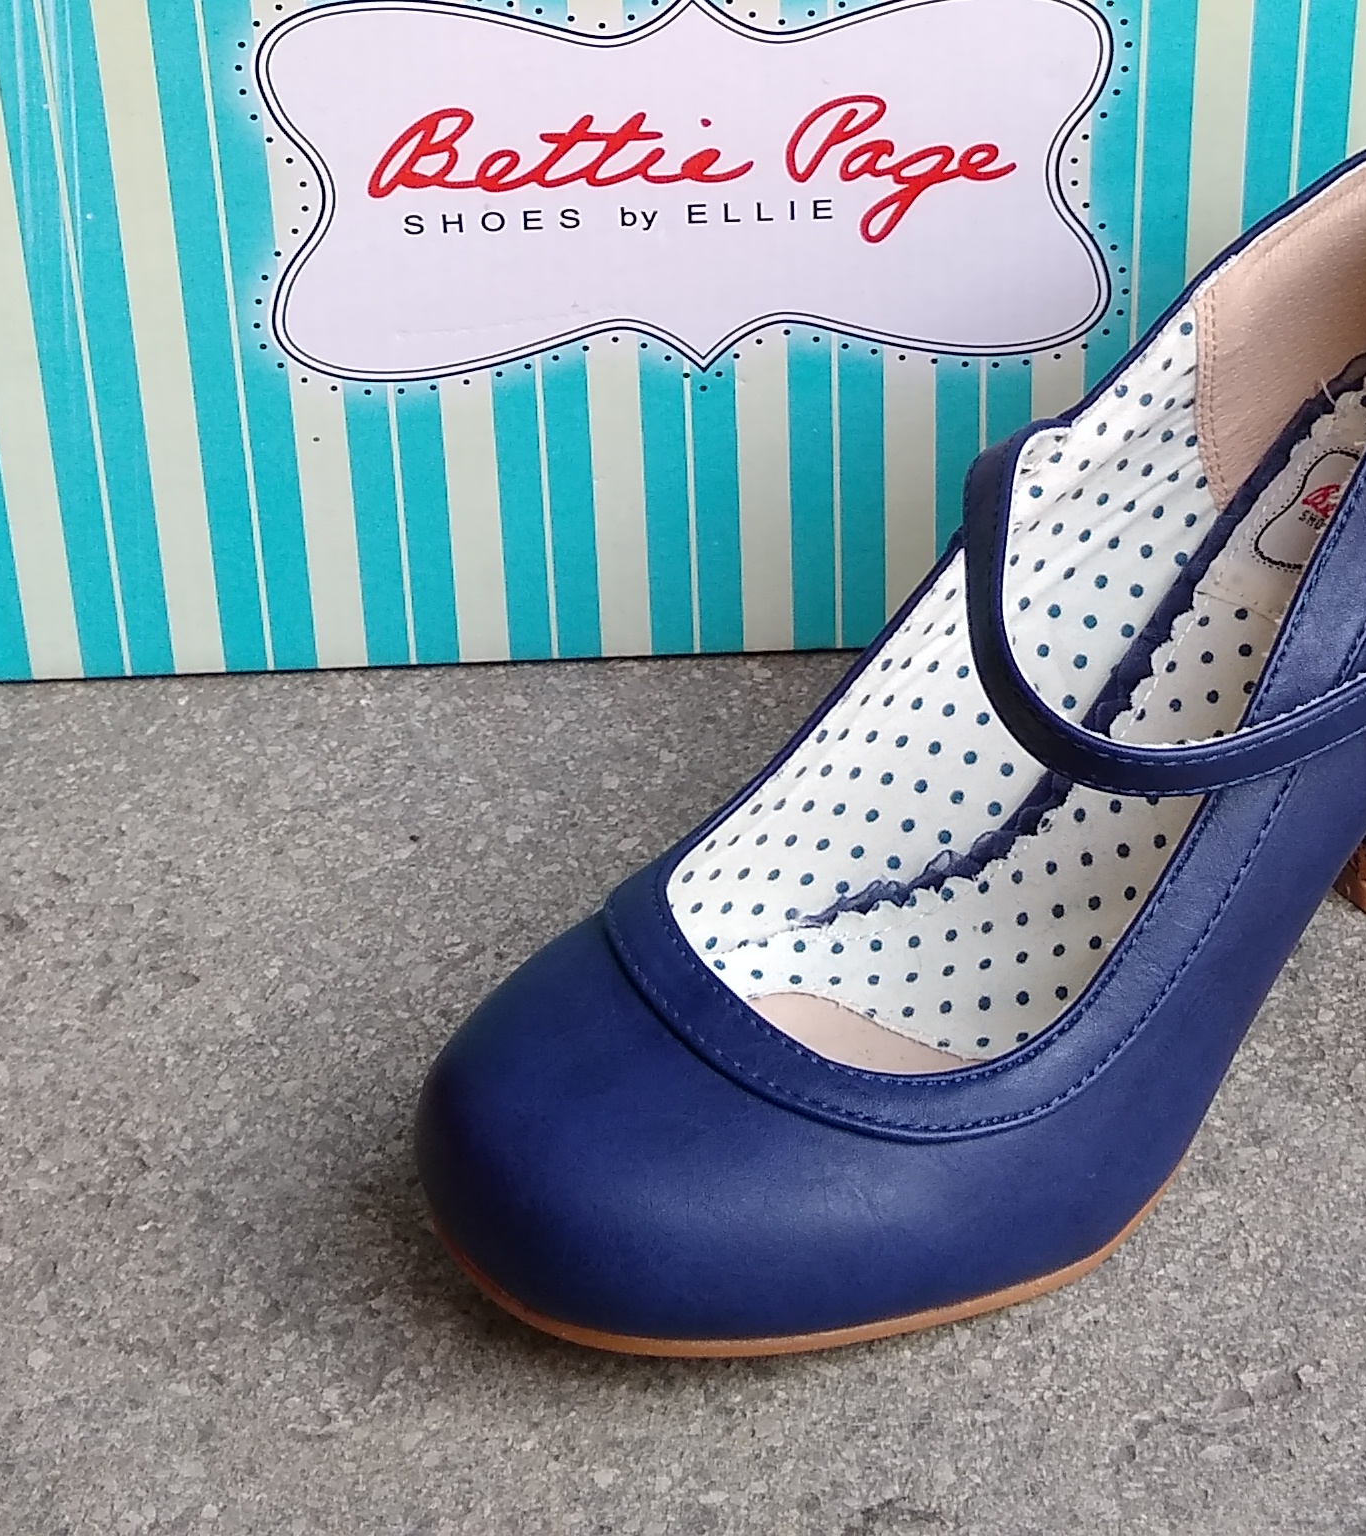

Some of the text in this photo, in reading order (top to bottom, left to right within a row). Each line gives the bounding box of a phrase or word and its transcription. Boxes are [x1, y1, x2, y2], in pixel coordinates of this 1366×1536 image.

[366, 94, 1017, 245] Bettie Page
[402, 199, 834, 235] SHOES by ELLIE
